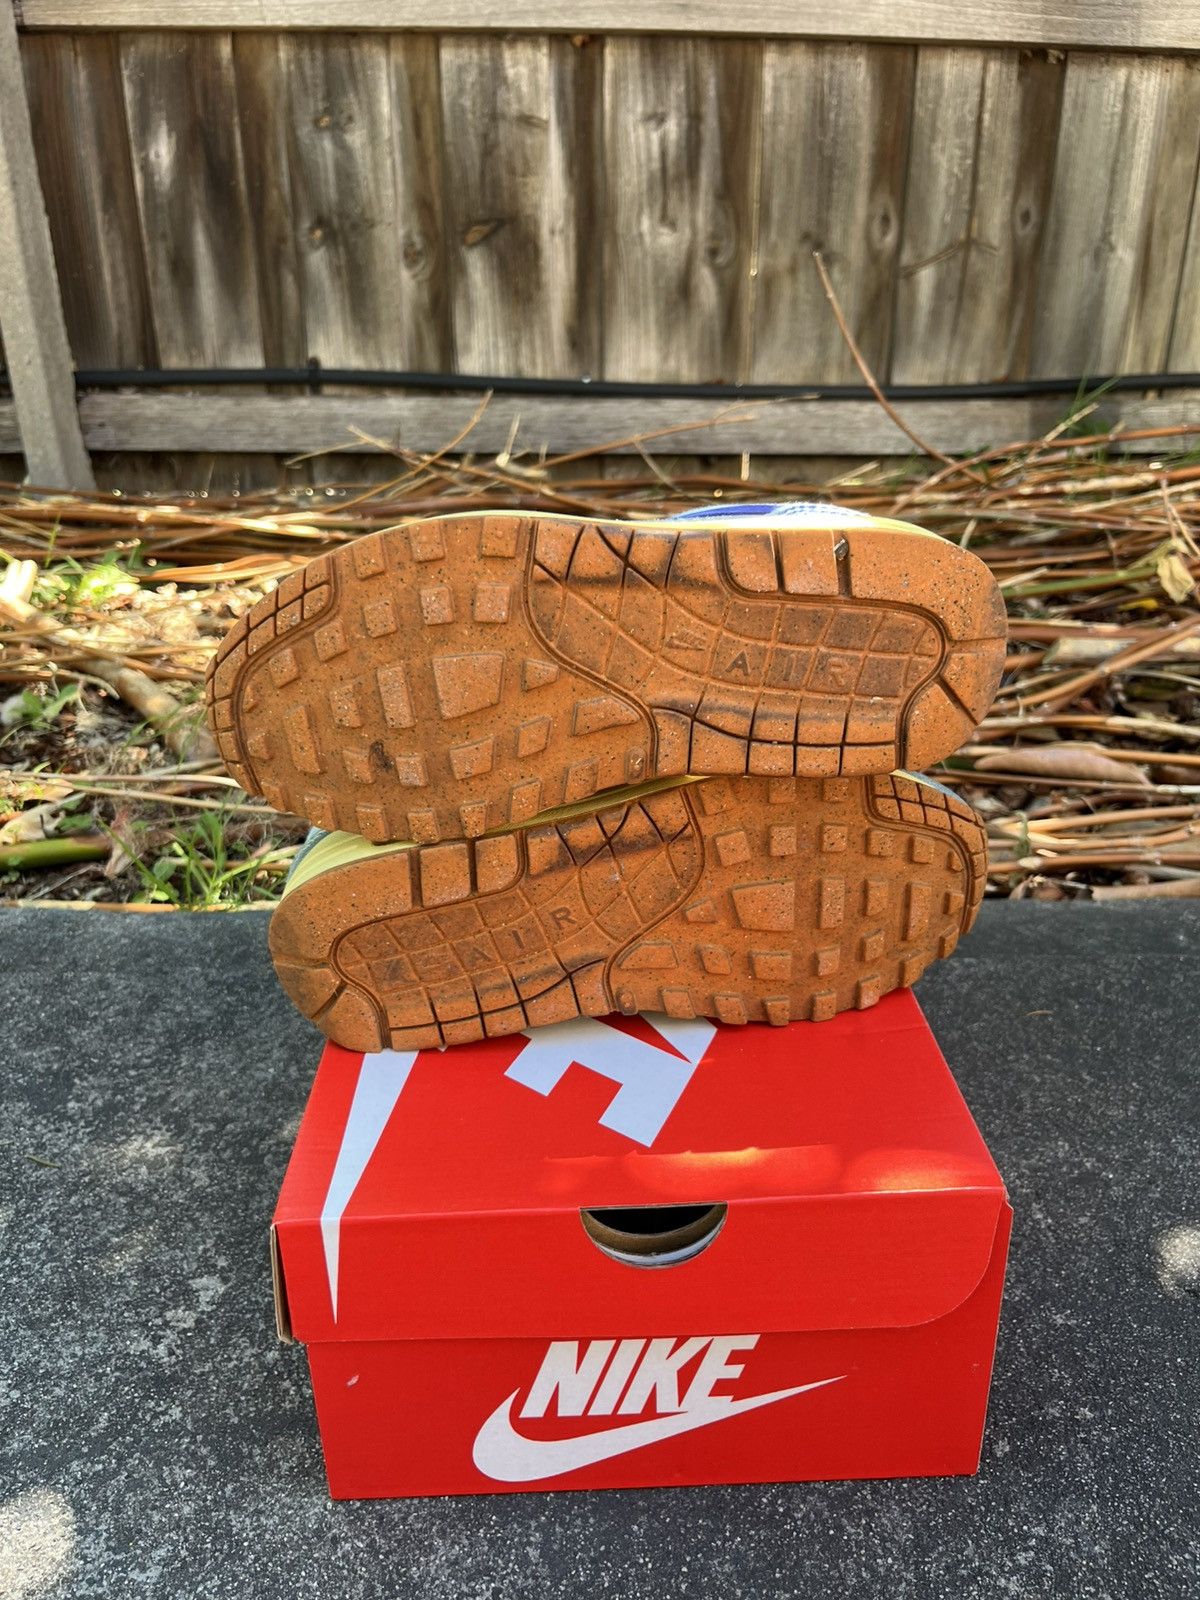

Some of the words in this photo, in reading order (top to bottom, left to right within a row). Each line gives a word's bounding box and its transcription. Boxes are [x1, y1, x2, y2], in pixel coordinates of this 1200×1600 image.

[725, 649, 846, 687] AIR
[463, 905, 578, 965] AIR
[518, 1333, 761, 1418] NIKE
